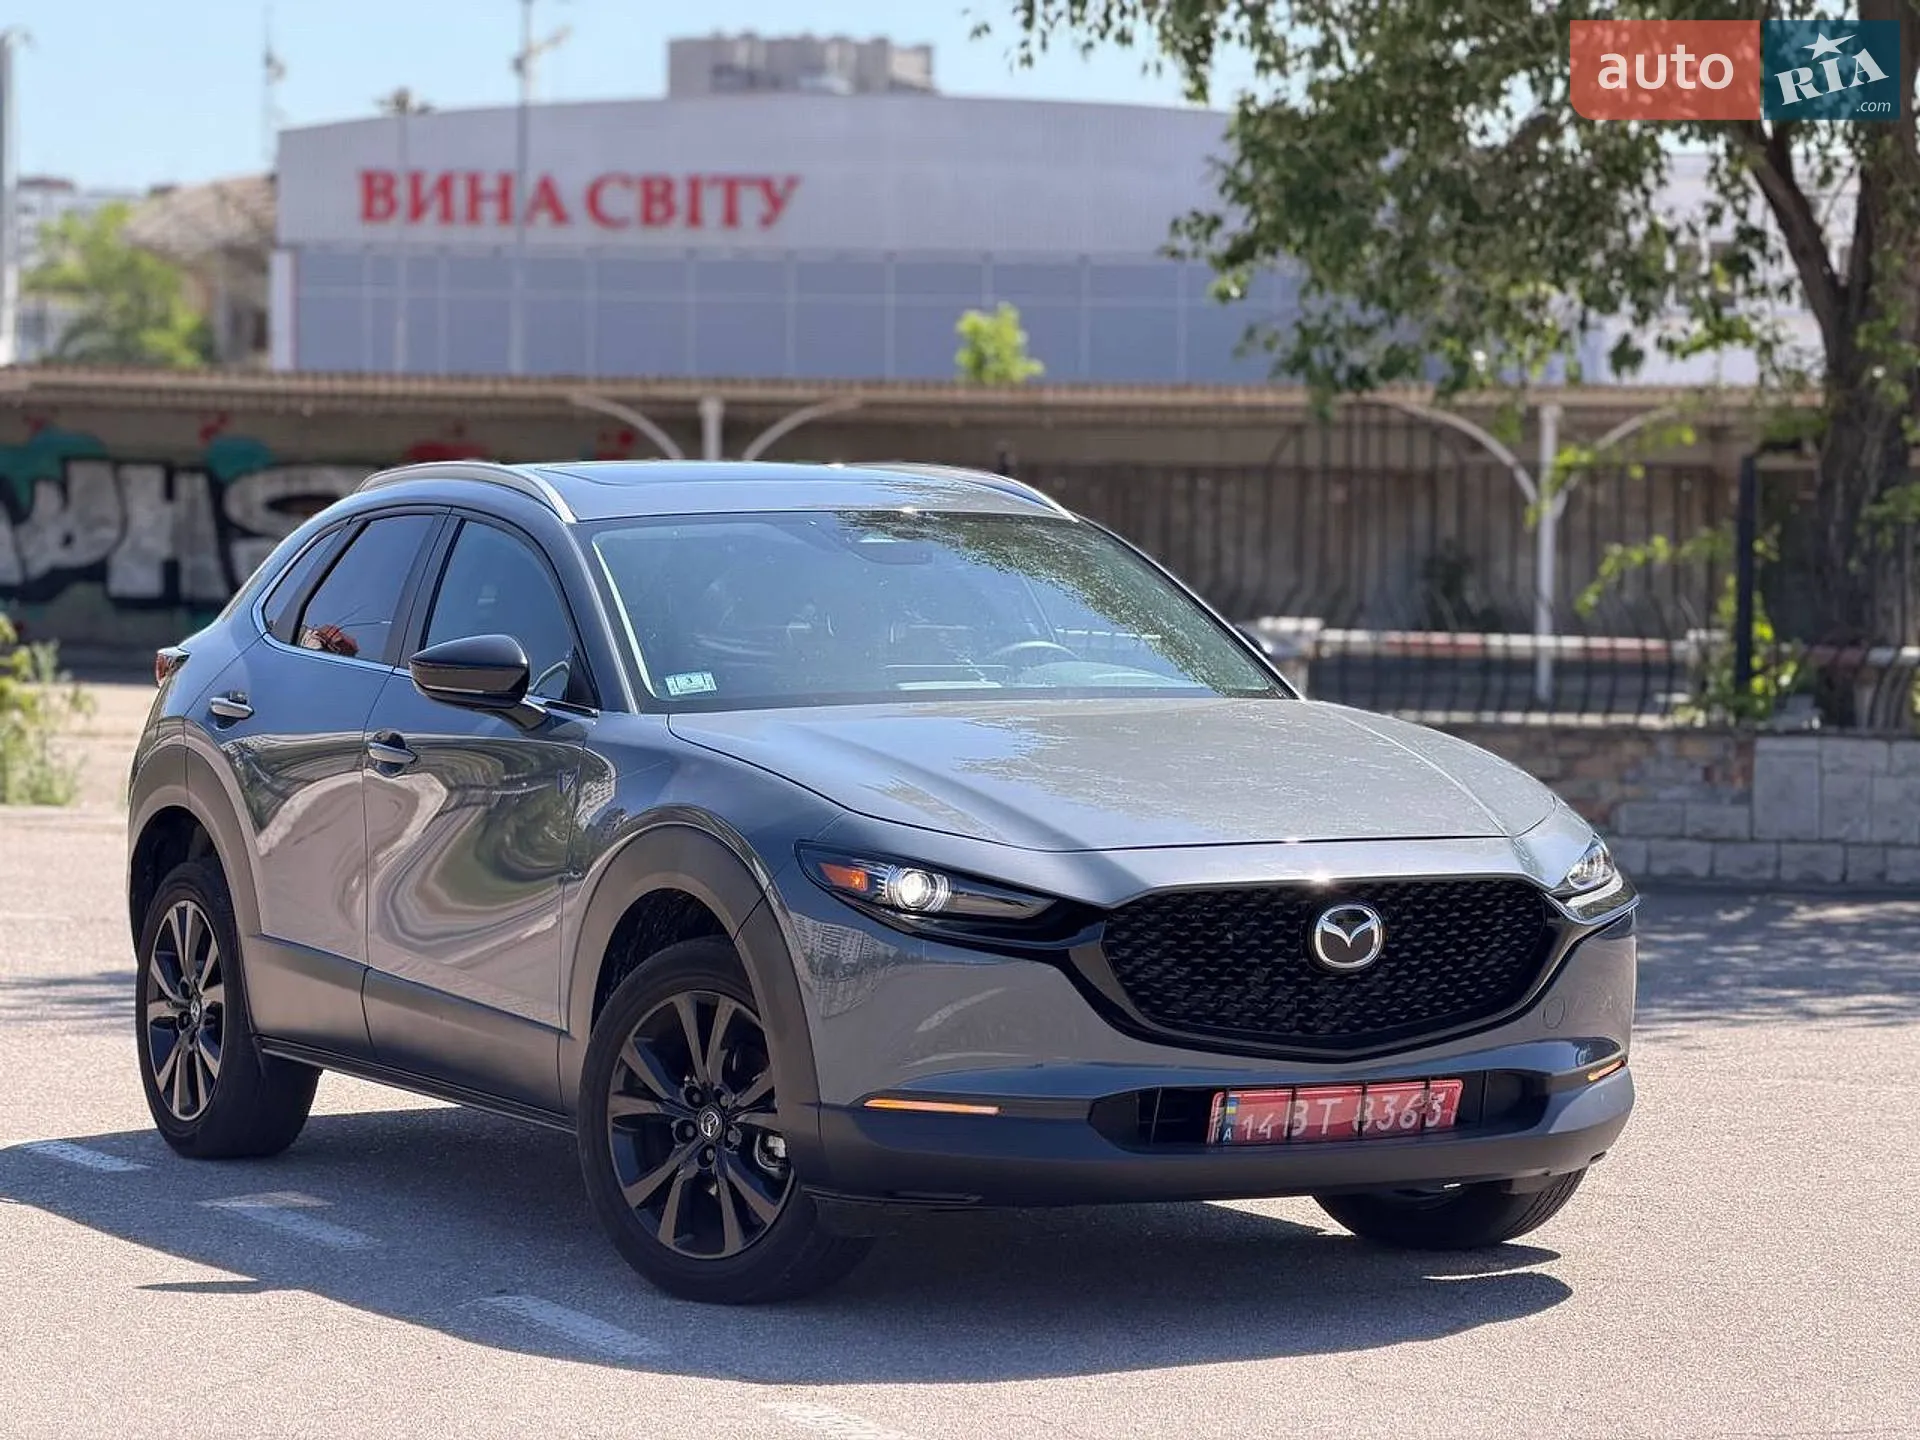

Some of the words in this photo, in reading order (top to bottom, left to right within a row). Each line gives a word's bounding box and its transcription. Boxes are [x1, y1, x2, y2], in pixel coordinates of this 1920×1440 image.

[359, 168, 569, 226] ВИНА
[585, 172, 802, 230] СВІТУ
[1242, 1113, 1275, 1141] 14
